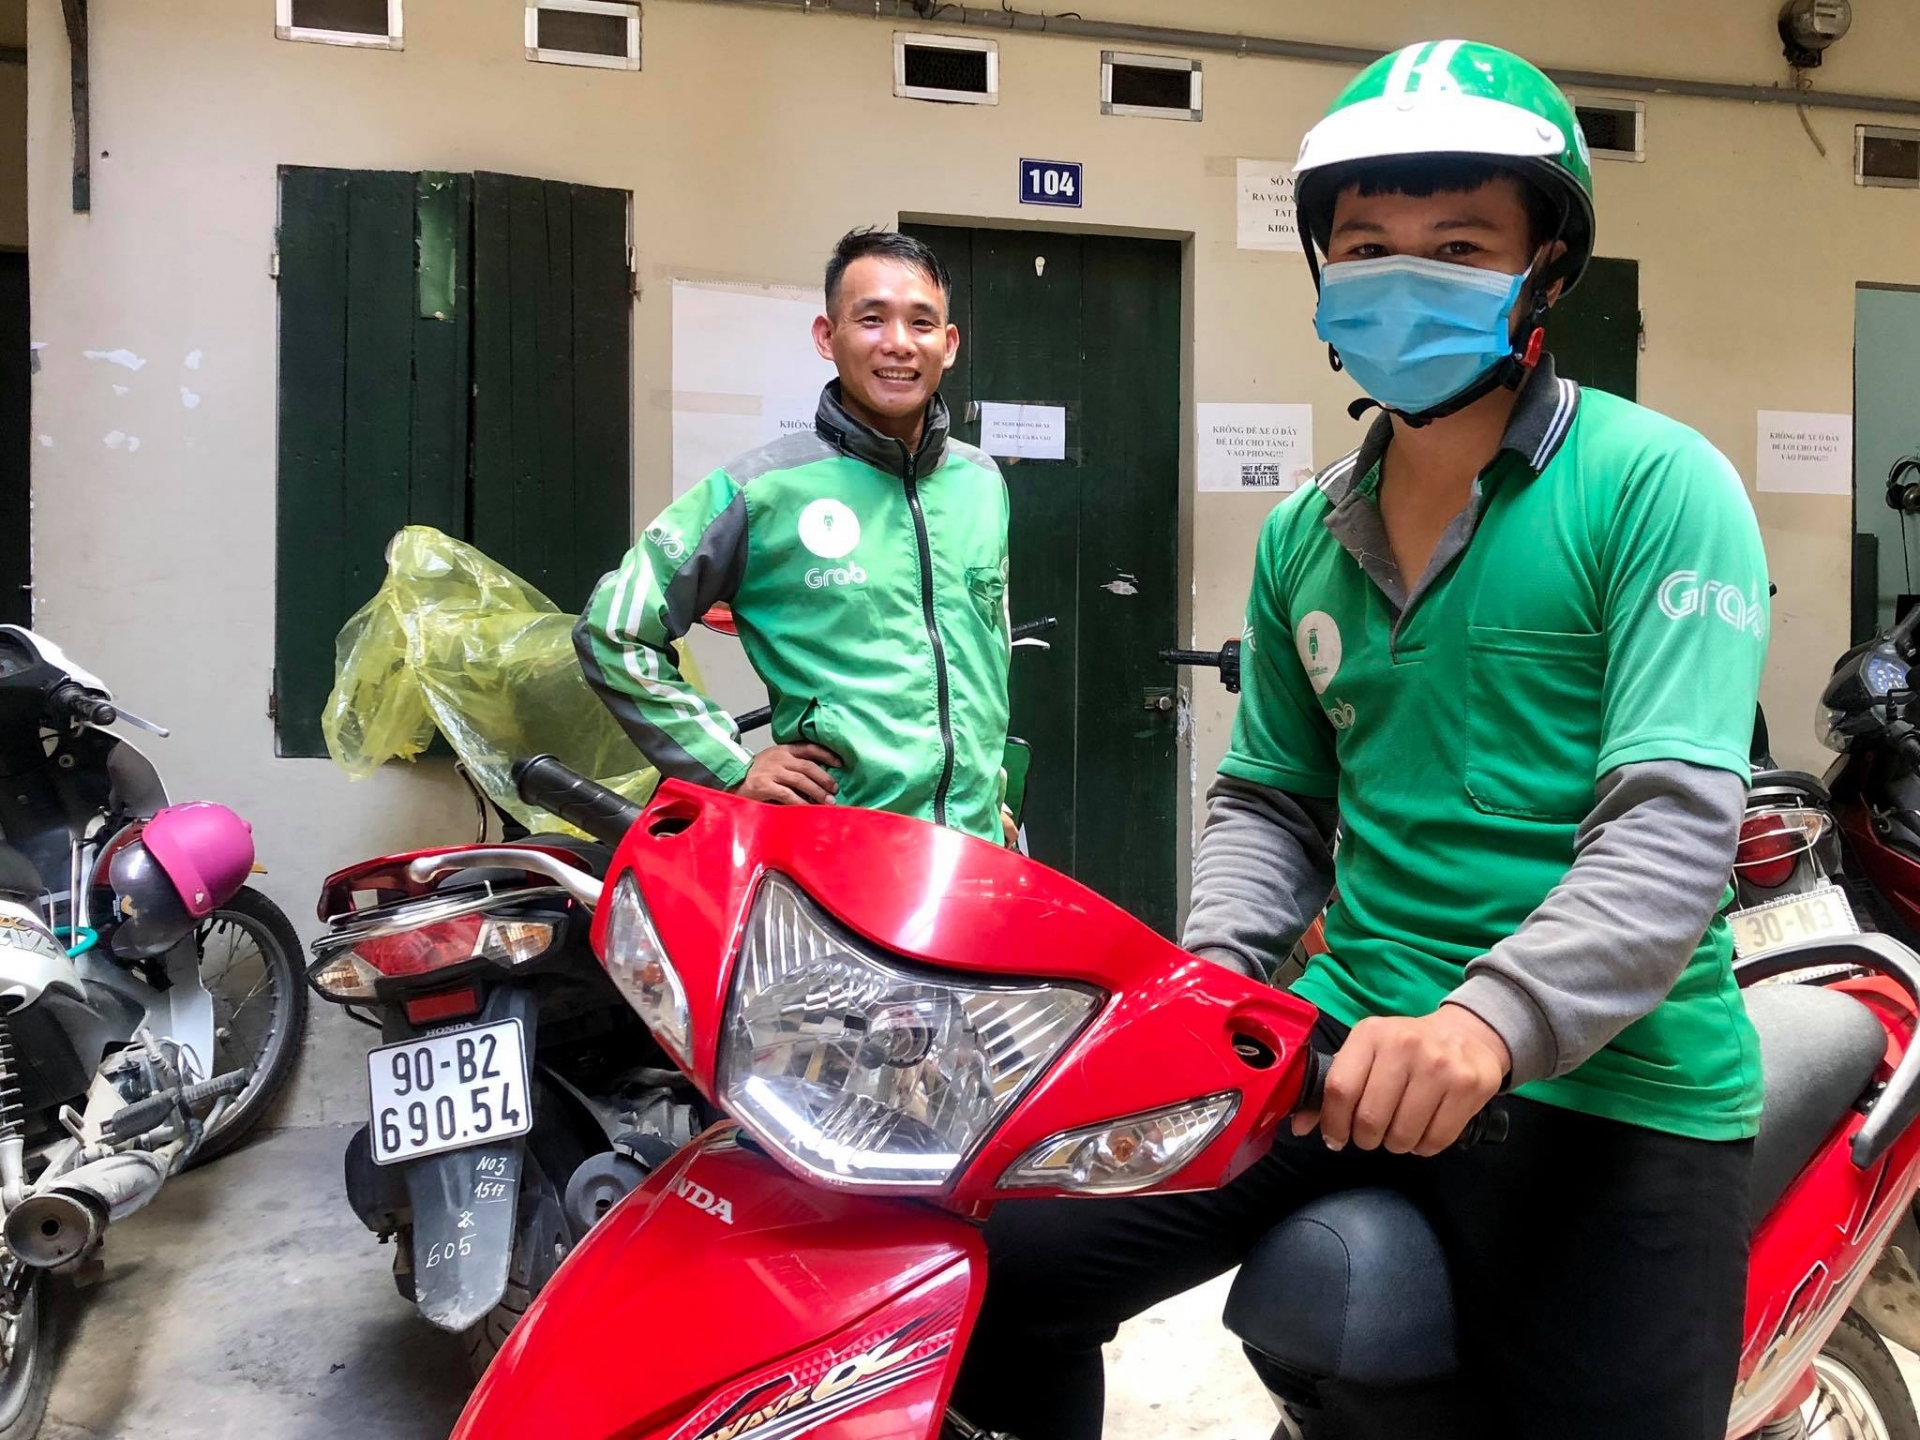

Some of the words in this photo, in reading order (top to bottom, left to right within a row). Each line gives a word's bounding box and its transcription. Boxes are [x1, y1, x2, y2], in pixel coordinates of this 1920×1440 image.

[1029, 169, 1075, 196] 104
[1252, 192, 1265, 201] RA
[780, 419, 816, 430] KHÔNG
[1212, 424, 1244, 434] KHÔNG
[1259, 427, 1271, 435] XE
[1769, 431, 1796, 440] KHÔNG
[1245, 438, 1264, 447] CHO
[644, 526, 685, 559] ab
[804, 560, 867, 589] Grab
[1657, 569, 1766, 642] Grab
[1326, 697, 1355, 730] ab
[1746, 899, 1834, 948] 30-N3
[0, 927, 59, 961] AVE
[426, 1022, 474, 1037] HONDA
[391, 1033, 500, 1096] 90-B2
[380, 1082, 520, 1153] 690.54
[474, 1182, 505, 1198] 1517
[671, 1177, 734, 1225] NDA
[426, 1233, 477, 1268] 605
